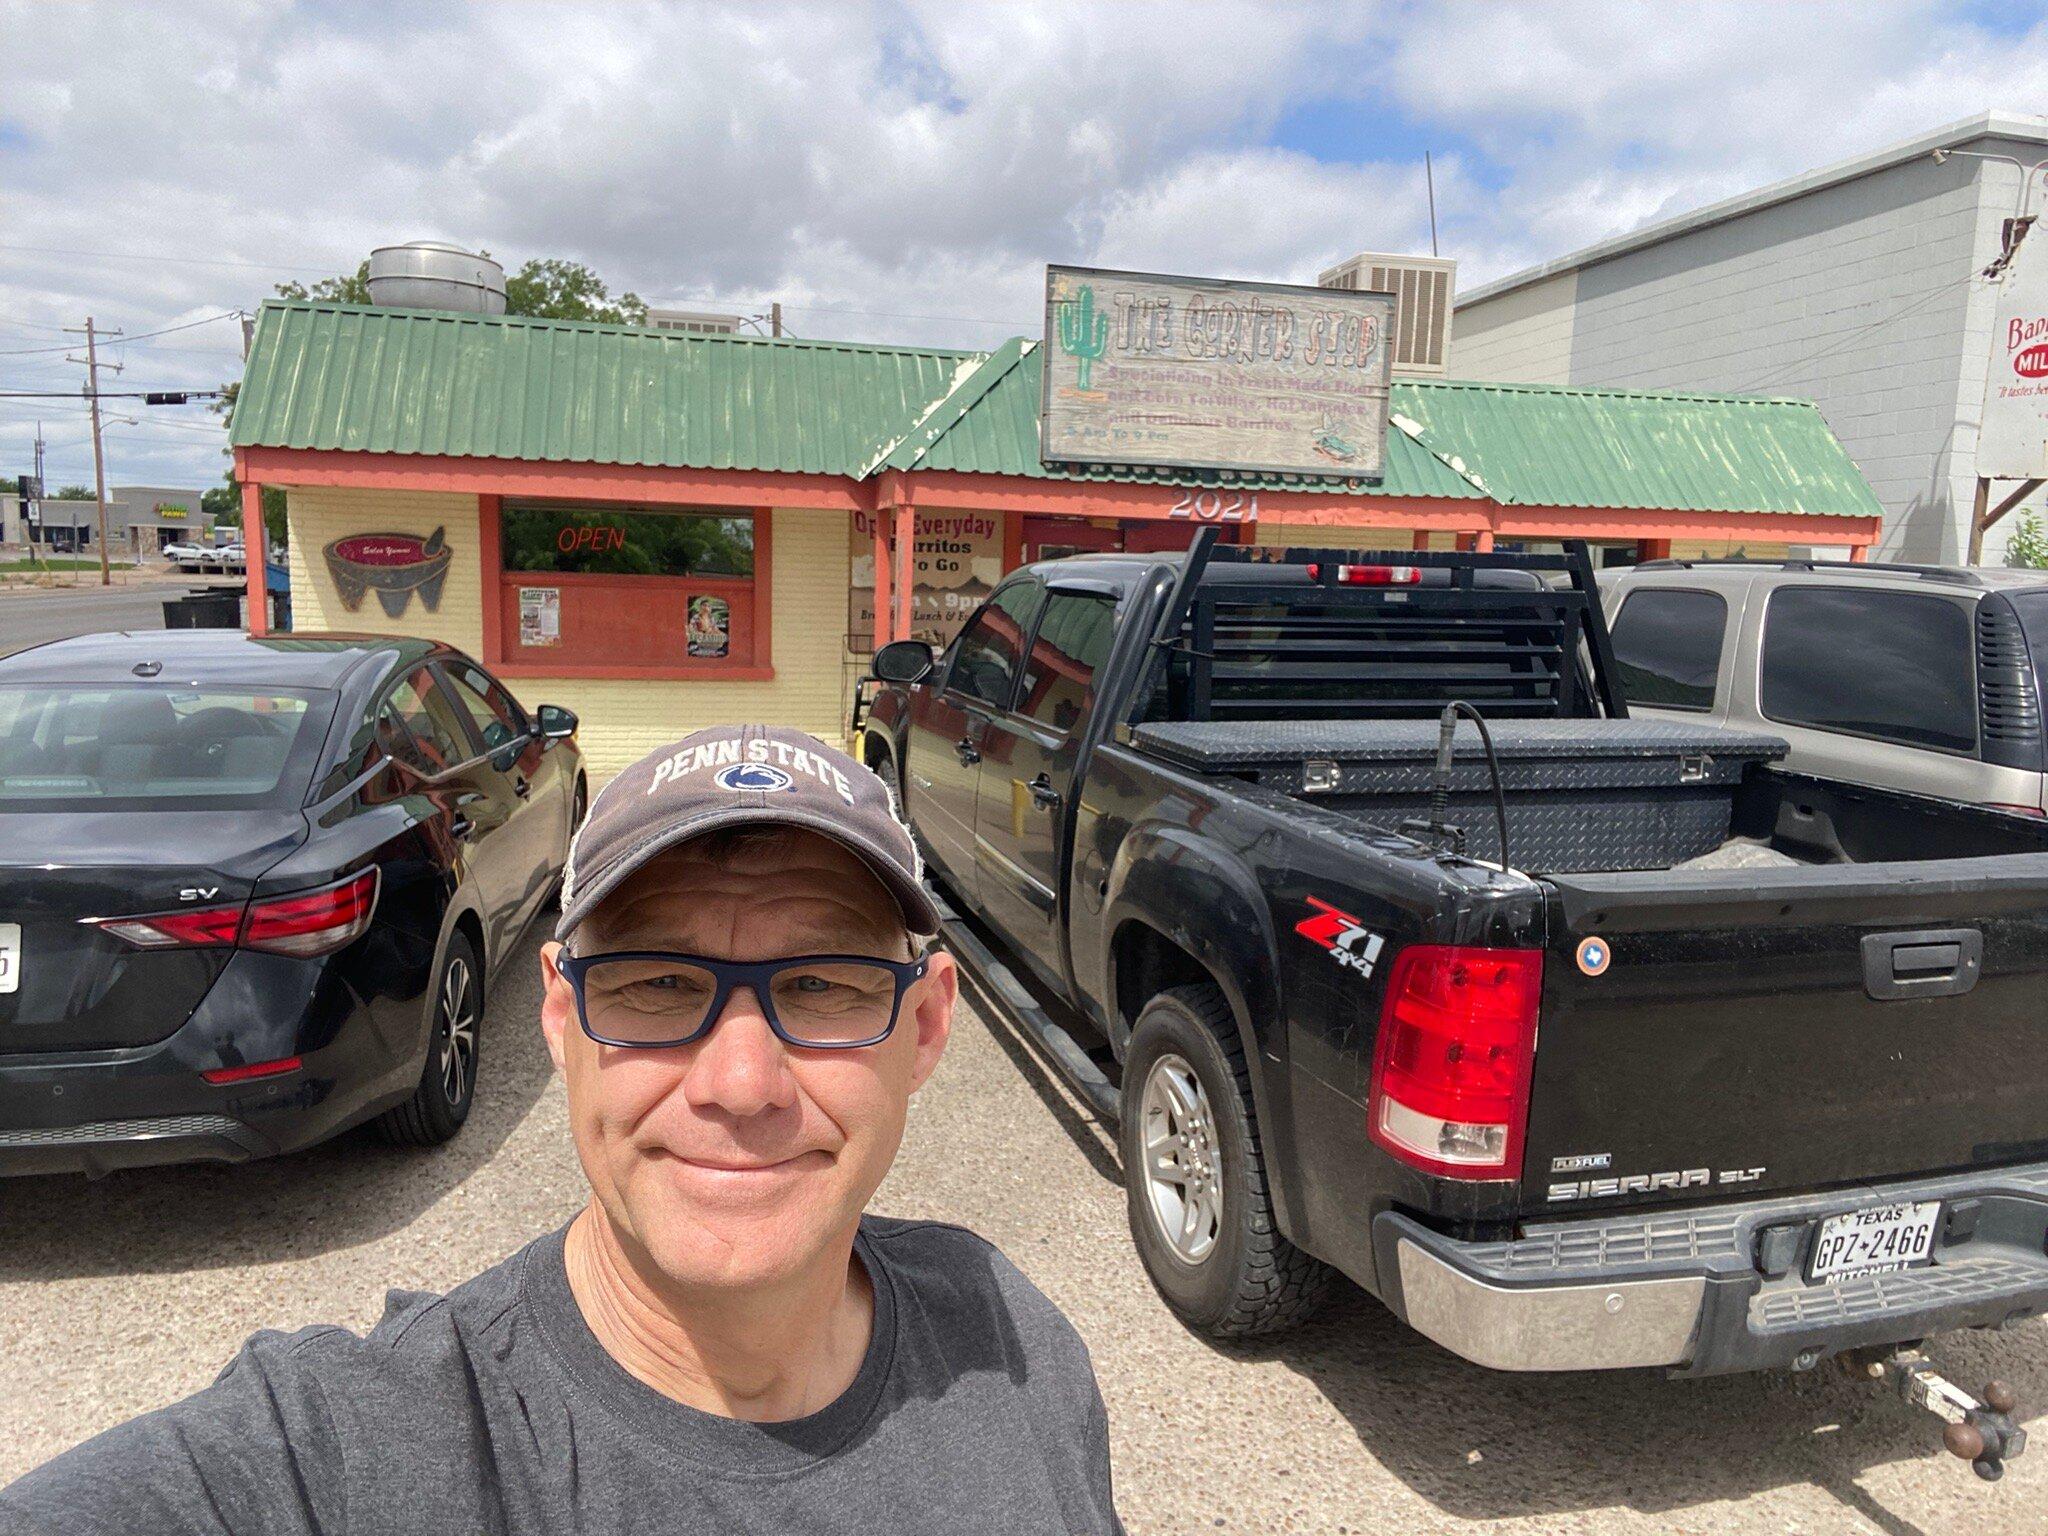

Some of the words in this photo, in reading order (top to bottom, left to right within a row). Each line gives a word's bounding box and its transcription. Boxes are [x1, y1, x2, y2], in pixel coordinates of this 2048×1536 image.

[1114, 292, 1171, 352] THE
[1184, 294, 1294, 364] CORNER
[1305, 311, 1380, 367] STOP
[2007, 318, 2048, 350] Ban
[1169, 490, 1258, 521] 2021
[558, 526, 627, 552] OPEN
[935, 558, 960, 572] Go
[647, 738, 742, 796] PENN
[748, 738, 855, 805] STATE
[180, 887, 219, 902] SV
[1547, 1168, 1711, 1202] SIERRA
[1718, 1167, 1767, 1185] SLT
[1855, 1208, 1904, 1226] TEXAS
